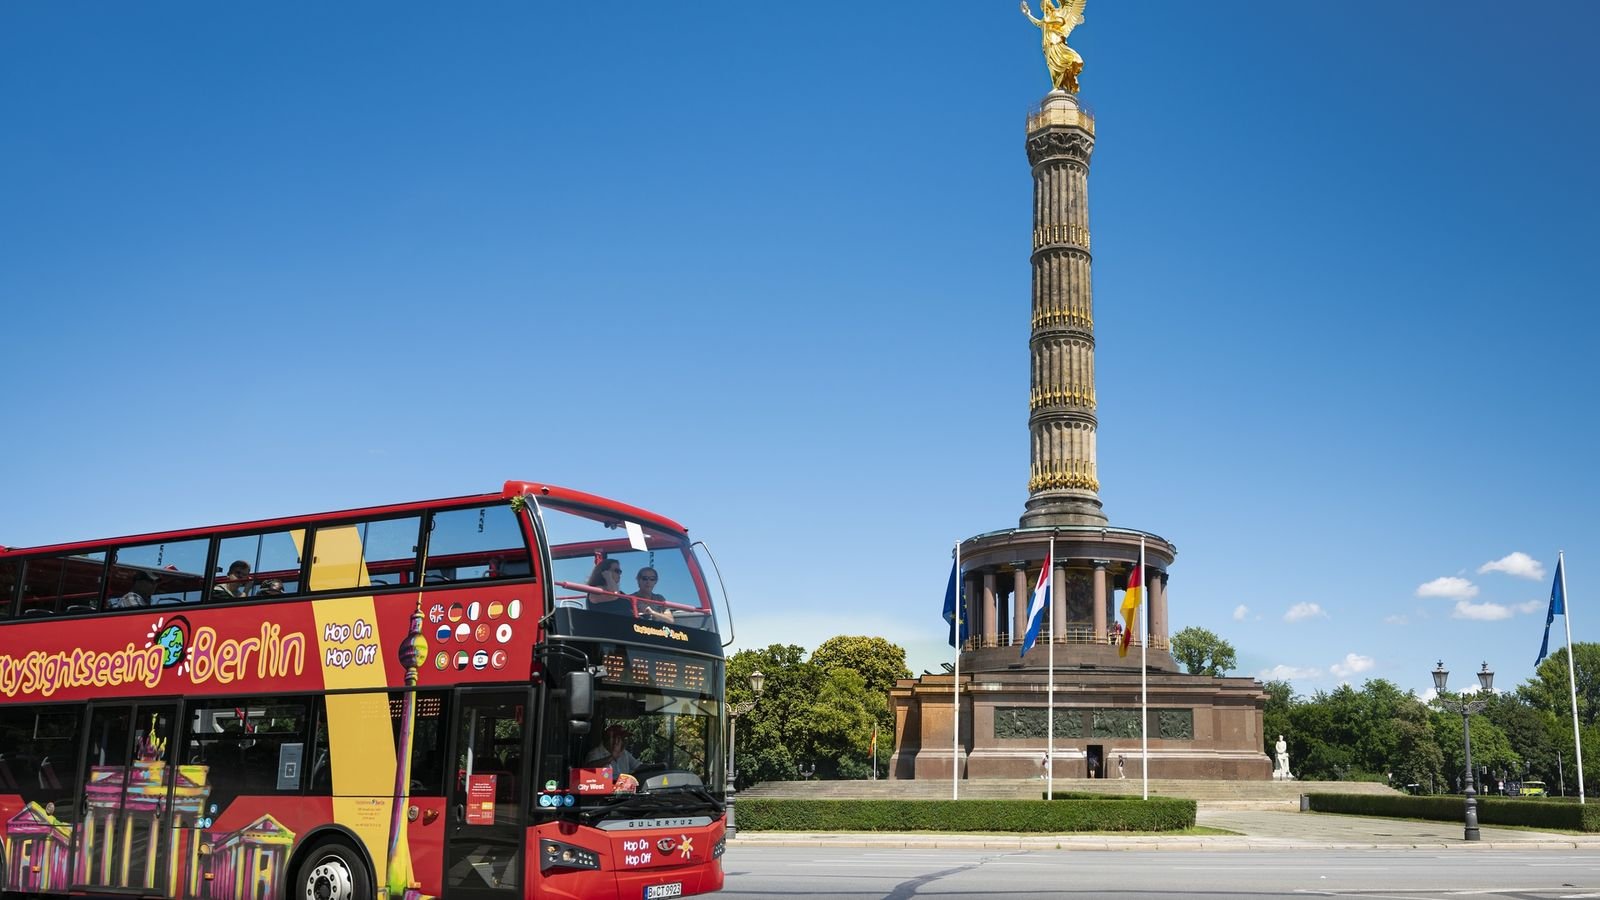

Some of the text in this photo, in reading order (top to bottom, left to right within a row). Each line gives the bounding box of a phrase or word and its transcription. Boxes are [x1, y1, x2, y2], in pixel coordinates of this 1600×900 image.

[324, 619, 372, 644] Hop On
[190, 621, 305, 684] Berlin
[326, 644, 377, 669] Hop Off
[623, 839, 649, 852] Hop On
[625, 852, 652, 866] Hop Off
